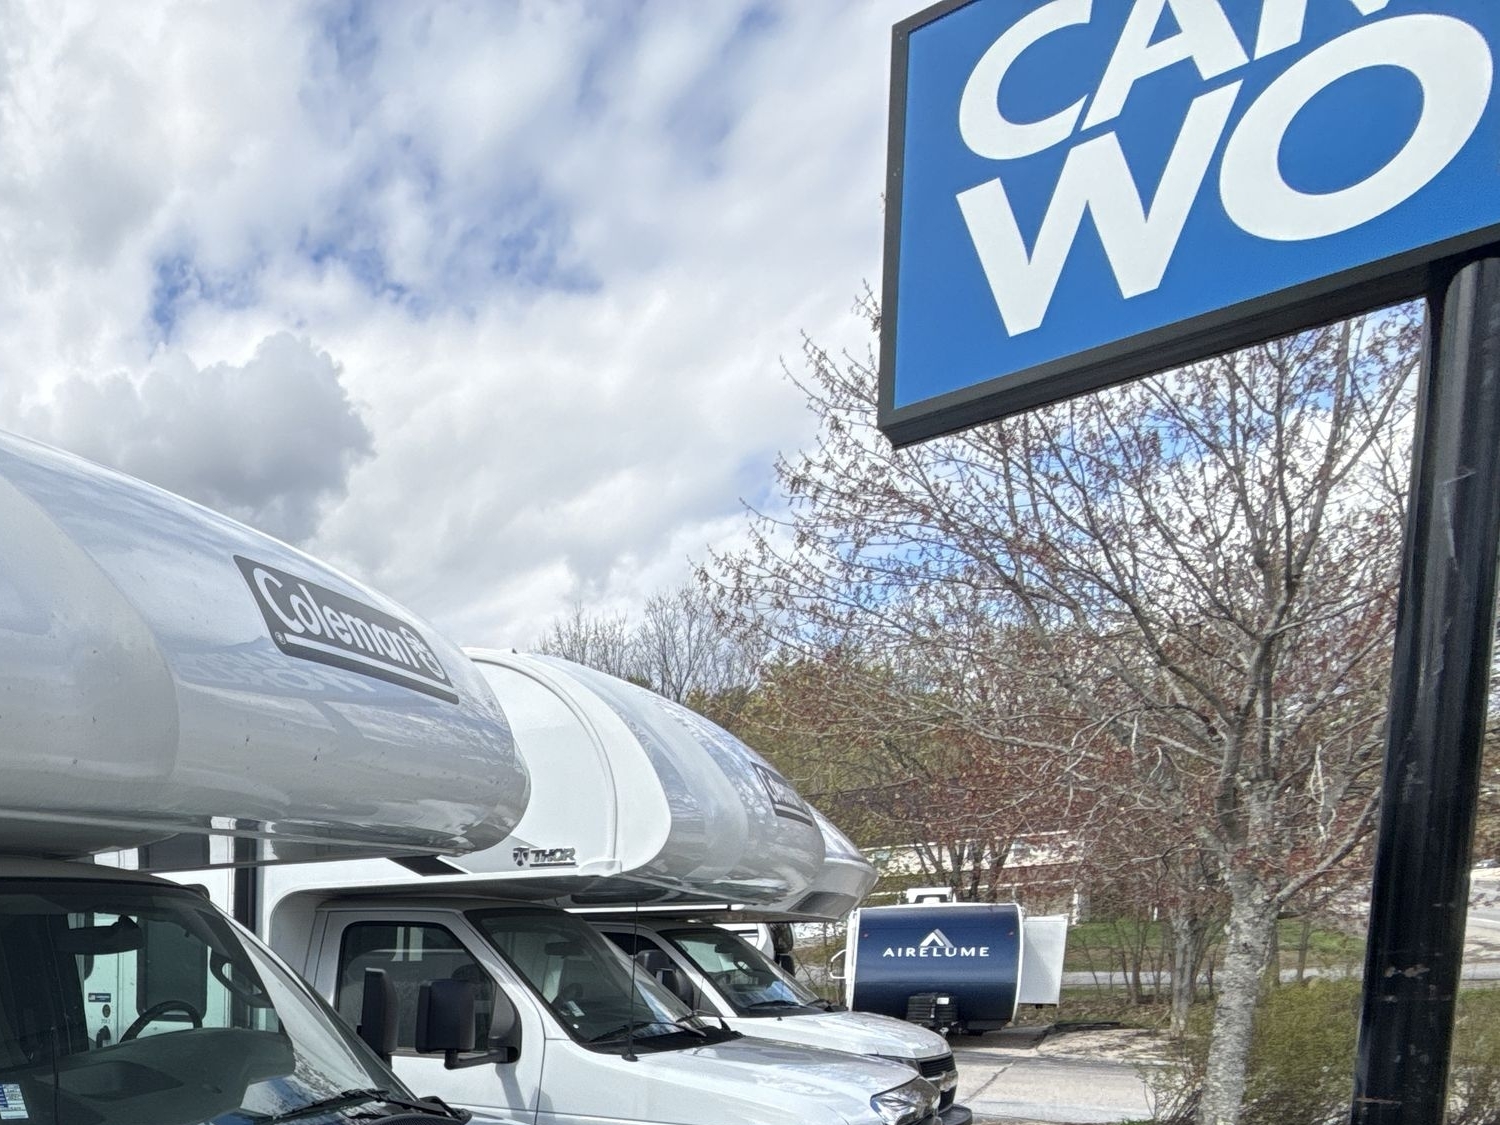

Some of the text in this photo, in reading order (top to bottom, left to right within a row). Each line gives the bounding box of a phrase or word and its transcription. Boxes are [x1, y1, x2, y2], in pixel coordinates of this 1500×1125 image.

[955, 14, 1493, 337] WO
[253, 567, 420, 669] Coleman
[530, 847, 577, 862] THOR
[882, 946, 990, 958] AIRELUME
